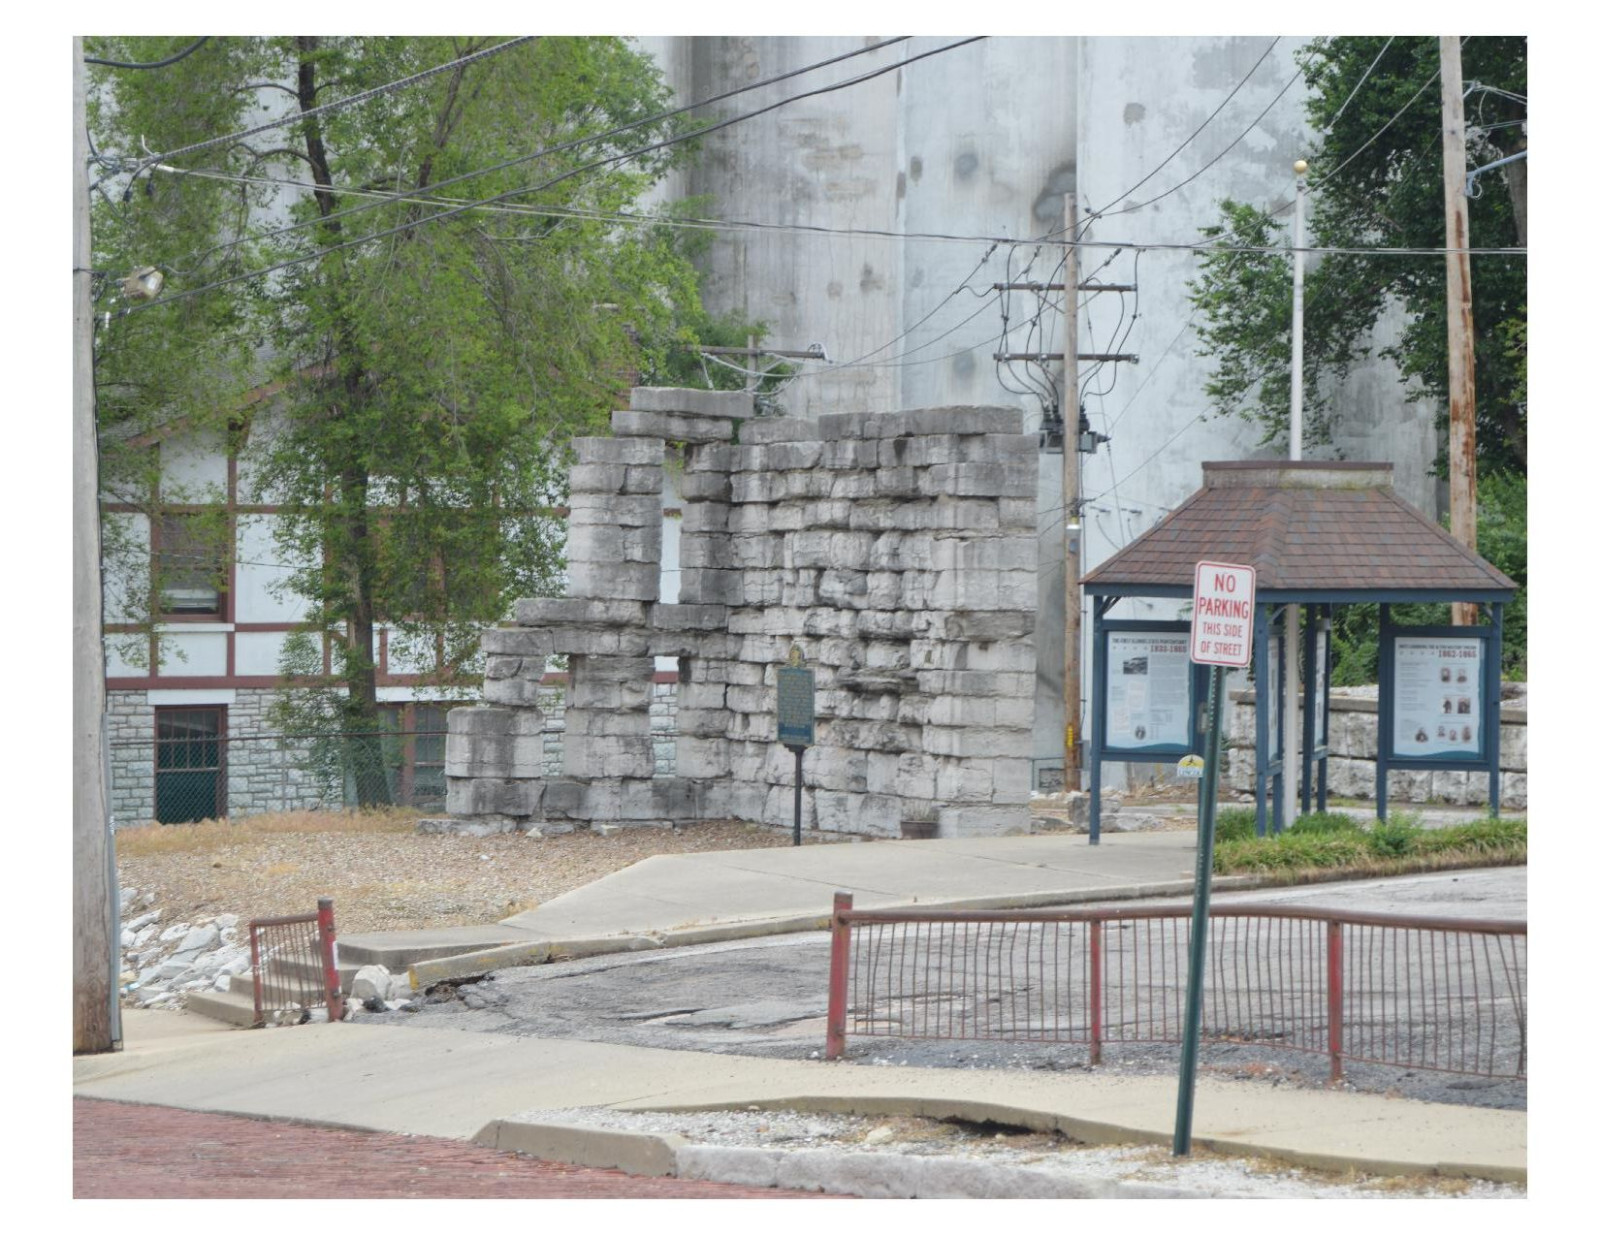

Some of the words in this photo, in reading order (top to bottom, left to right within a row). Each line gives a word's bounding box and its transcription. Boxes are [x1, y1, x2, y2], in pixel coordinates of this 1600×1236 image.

[1214, 573, 1236, 593] NO
[1198, 596, 1249, 620] PARKING
[1203, 621, 1221, 636] THIS
[1223, 624, 1243, 638] SIDE
[1200, 640, 1212, 654] OF
[1213, 642, 1242, 657] STREET
